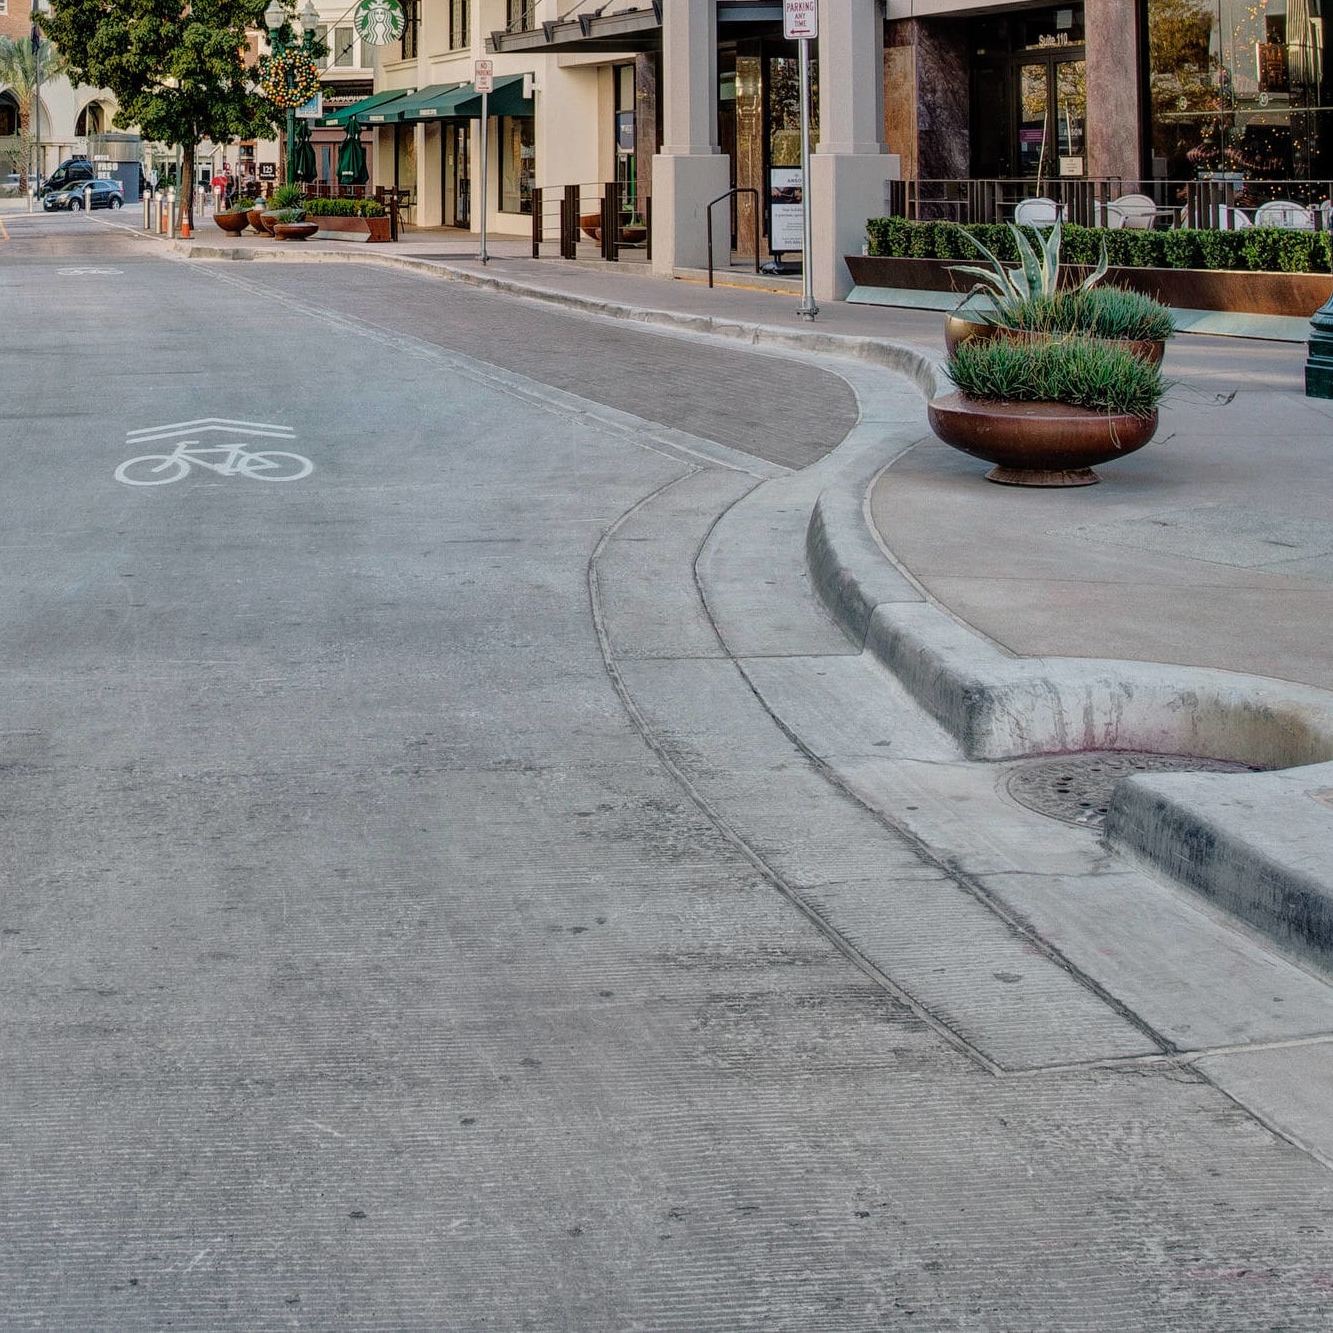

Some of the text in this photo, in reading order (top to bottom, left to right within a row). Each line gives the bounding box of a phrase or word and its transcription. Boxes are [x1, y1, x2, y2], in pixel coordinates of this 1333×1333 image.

[787, 1, 814, 12] PARKING
[794, 19, 807, 27] TIME
[1039, 32, 1068, 46] Suite 110
